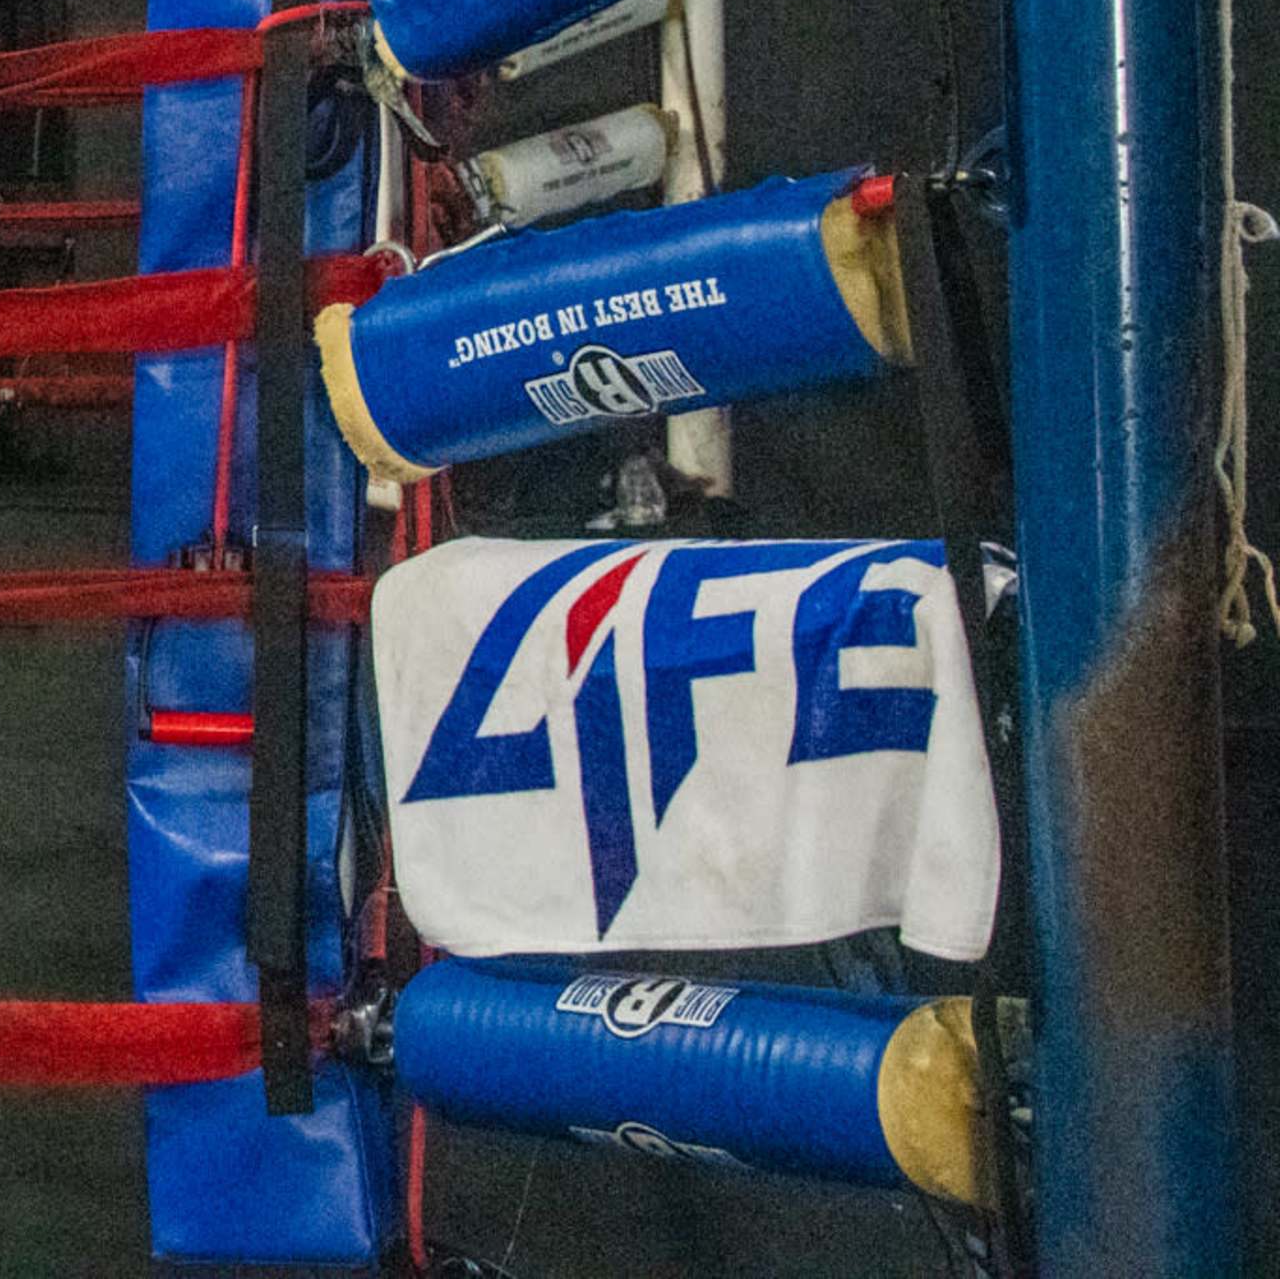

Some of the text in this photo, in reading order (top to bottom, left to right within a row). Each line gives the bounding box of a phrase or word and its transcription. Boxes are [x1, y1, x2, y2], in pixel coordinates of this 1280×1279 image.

[594, 288, 663, 326] BEST
[664, 277, 726, 312] THE
[557, 304, 588, 335] IN
